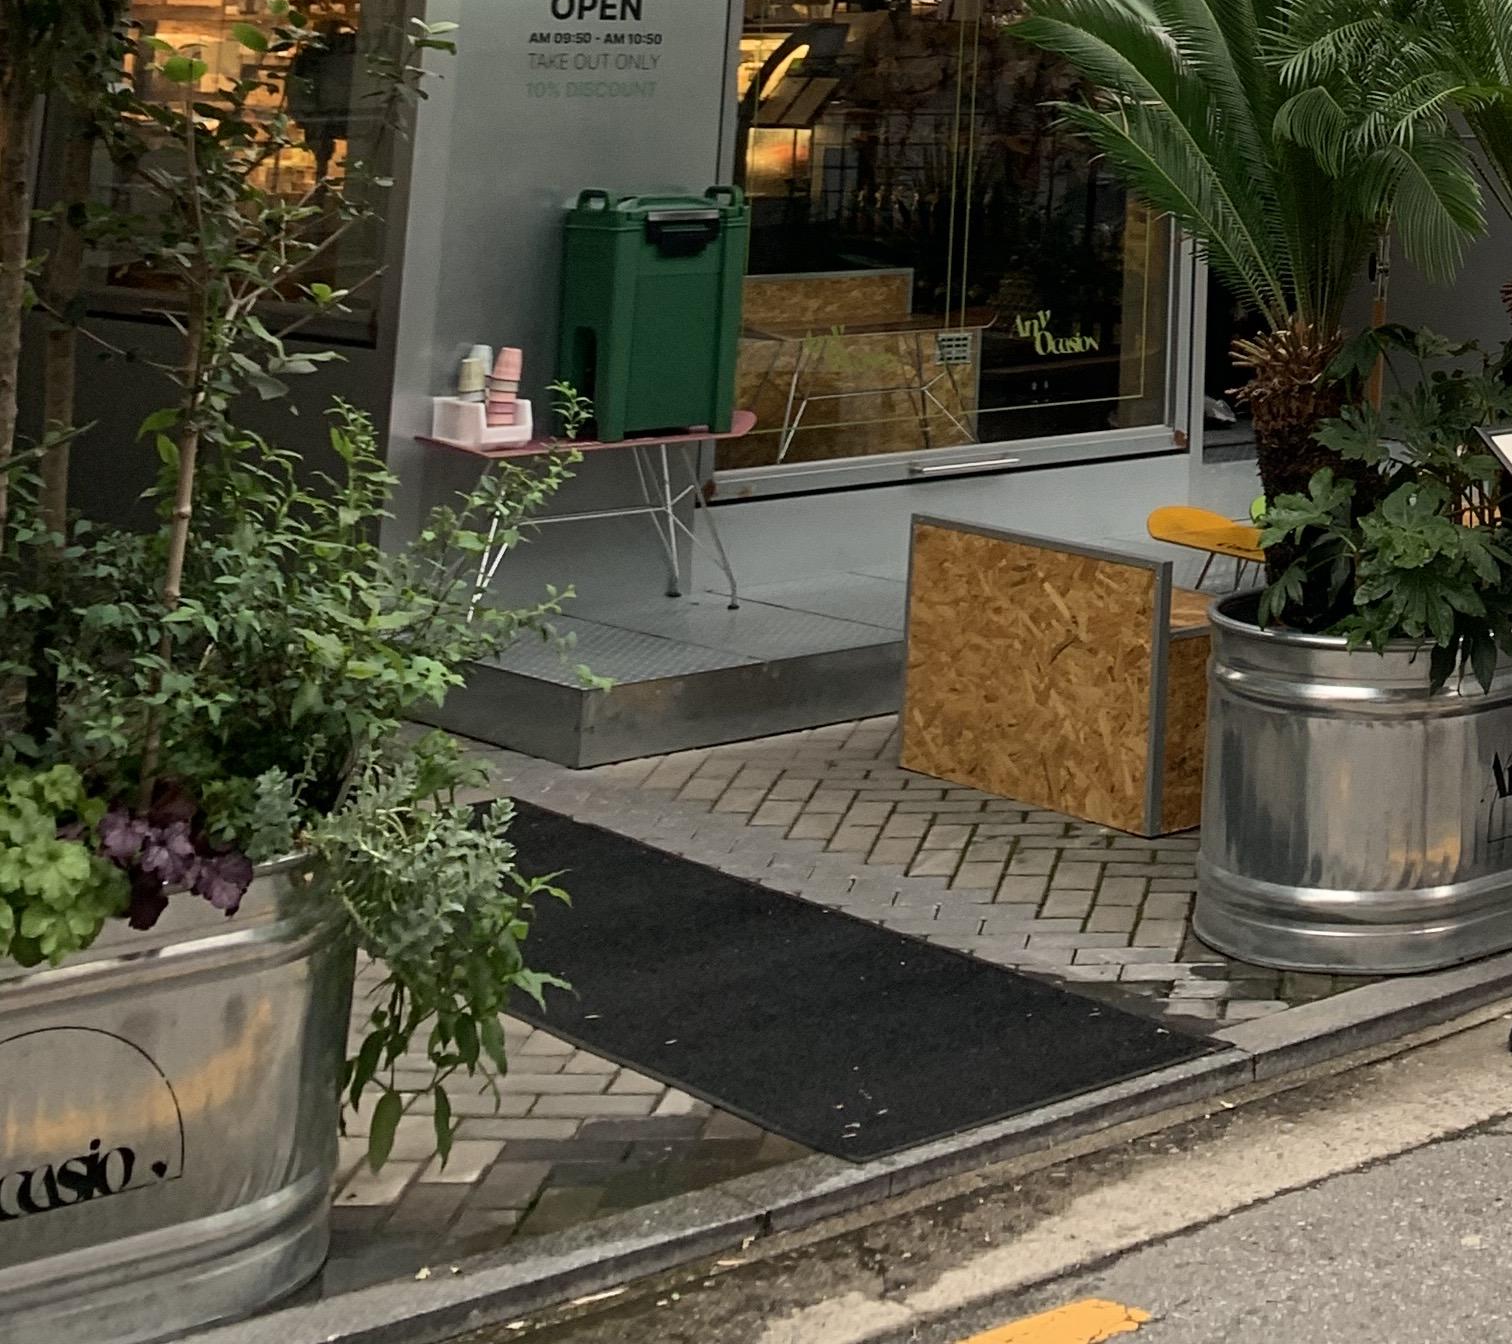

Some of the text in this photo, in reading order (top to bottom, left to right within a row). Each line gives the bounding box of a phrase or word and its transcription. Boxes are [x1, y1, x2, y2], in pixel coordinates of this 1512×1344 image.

[528, 32, 551, 44] AM
[603, 33, 625, 44] AM
[527, 52, 663, 71] TAKE OUT ONLY
